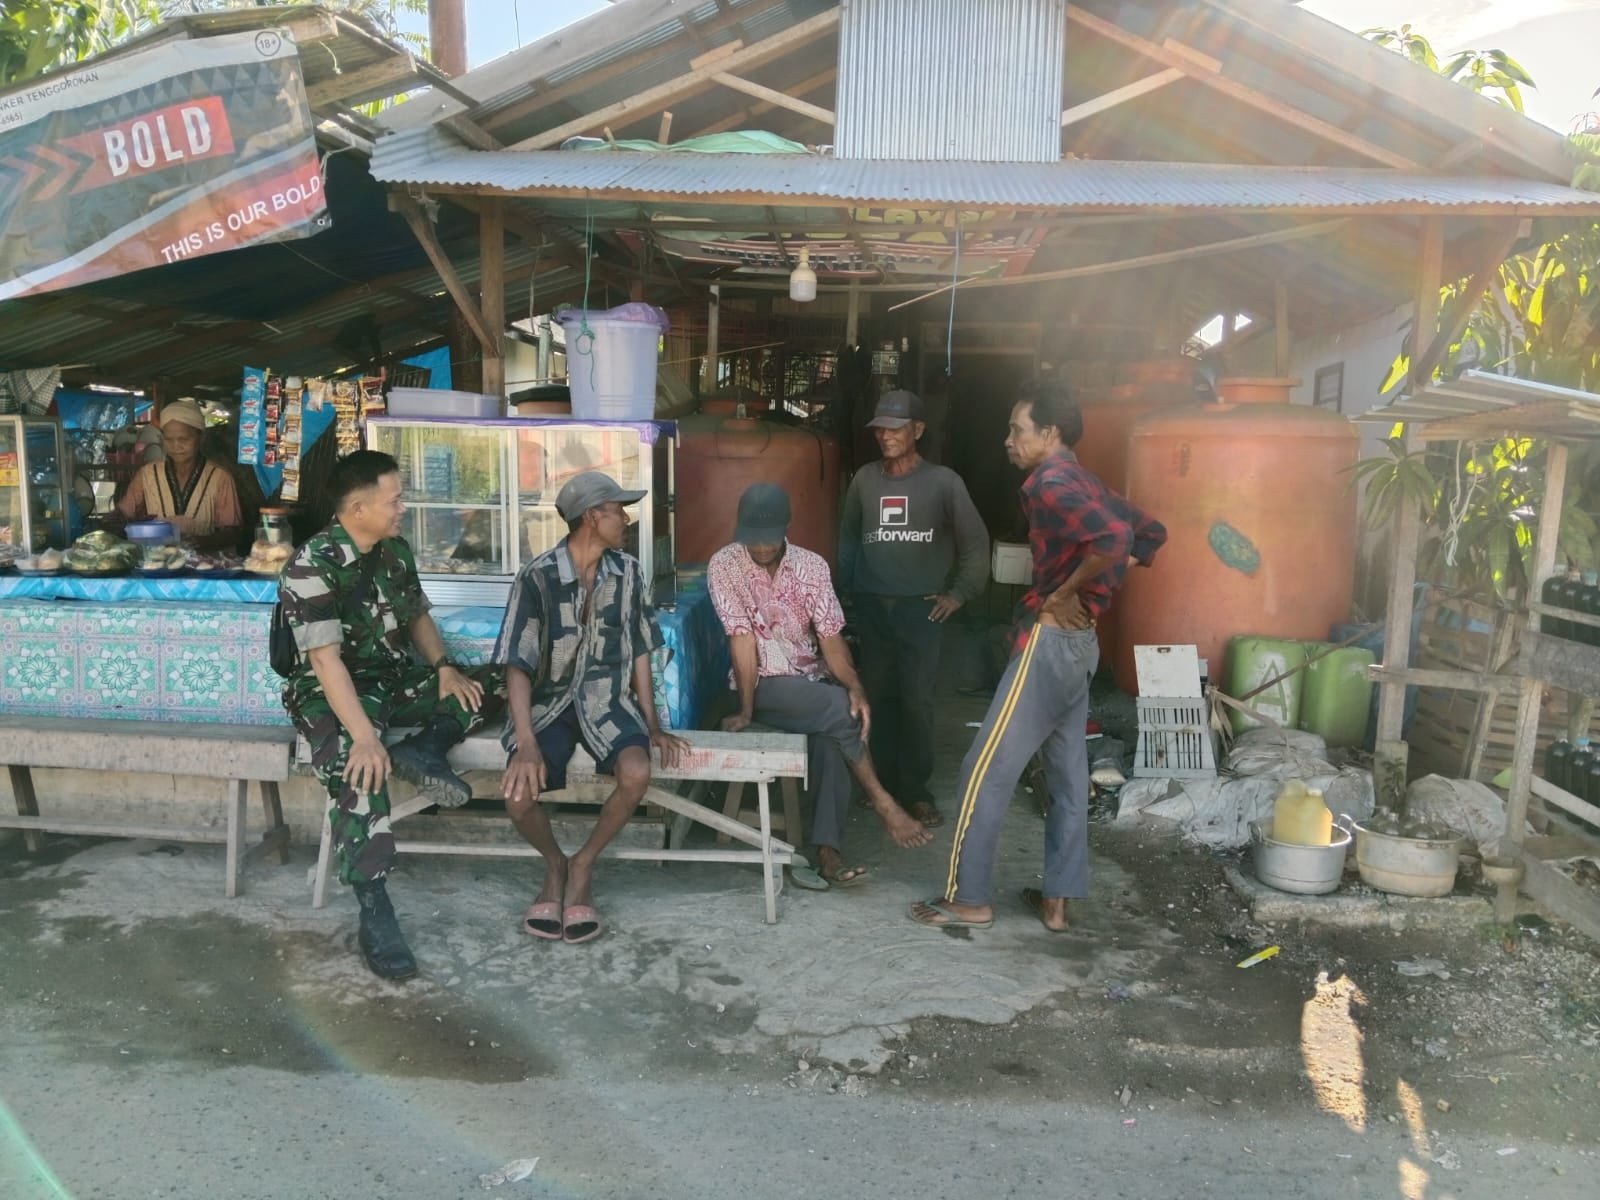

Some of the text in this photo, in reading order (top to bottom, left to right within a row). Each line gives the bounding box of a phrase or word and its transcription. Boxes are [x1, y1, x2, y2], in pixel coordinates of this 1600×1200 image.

[258, 38, 277, 49] 18+
[103, 106, 212, 177] BOLD
[161, 175, 320, 264] THIS IS OUR BOLD
[1251, 659, 1288, 721] A
